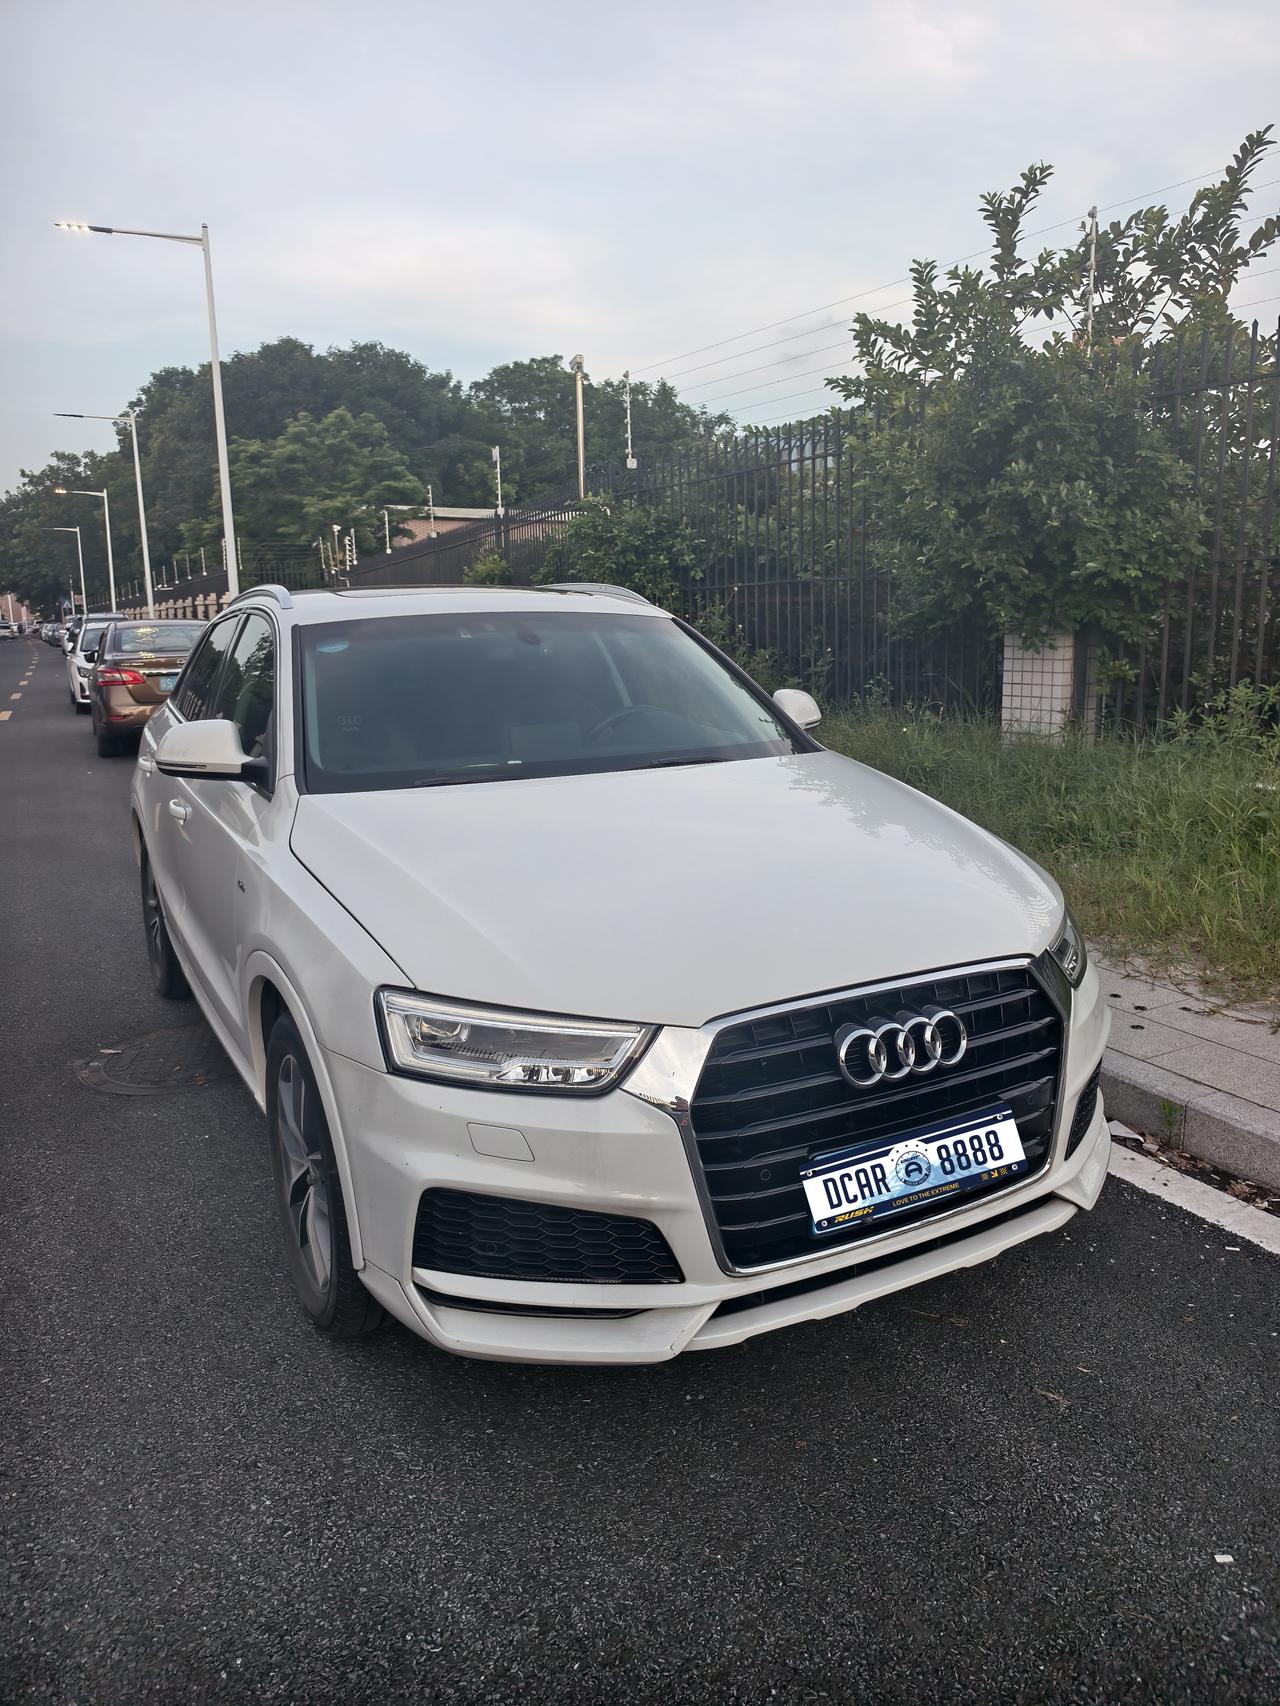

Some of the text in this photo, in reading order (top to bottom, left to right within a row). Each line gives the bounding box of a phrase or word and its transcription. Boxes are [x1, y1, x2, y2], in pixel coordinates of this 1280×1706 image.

[823, 1130, 1004, 1209] DCAR 8888
[893, 1198, 909, 1207] LOVE
[919, 1190, 931, 1199] THE
[931, 1182, 960, 1195] EXTREME
